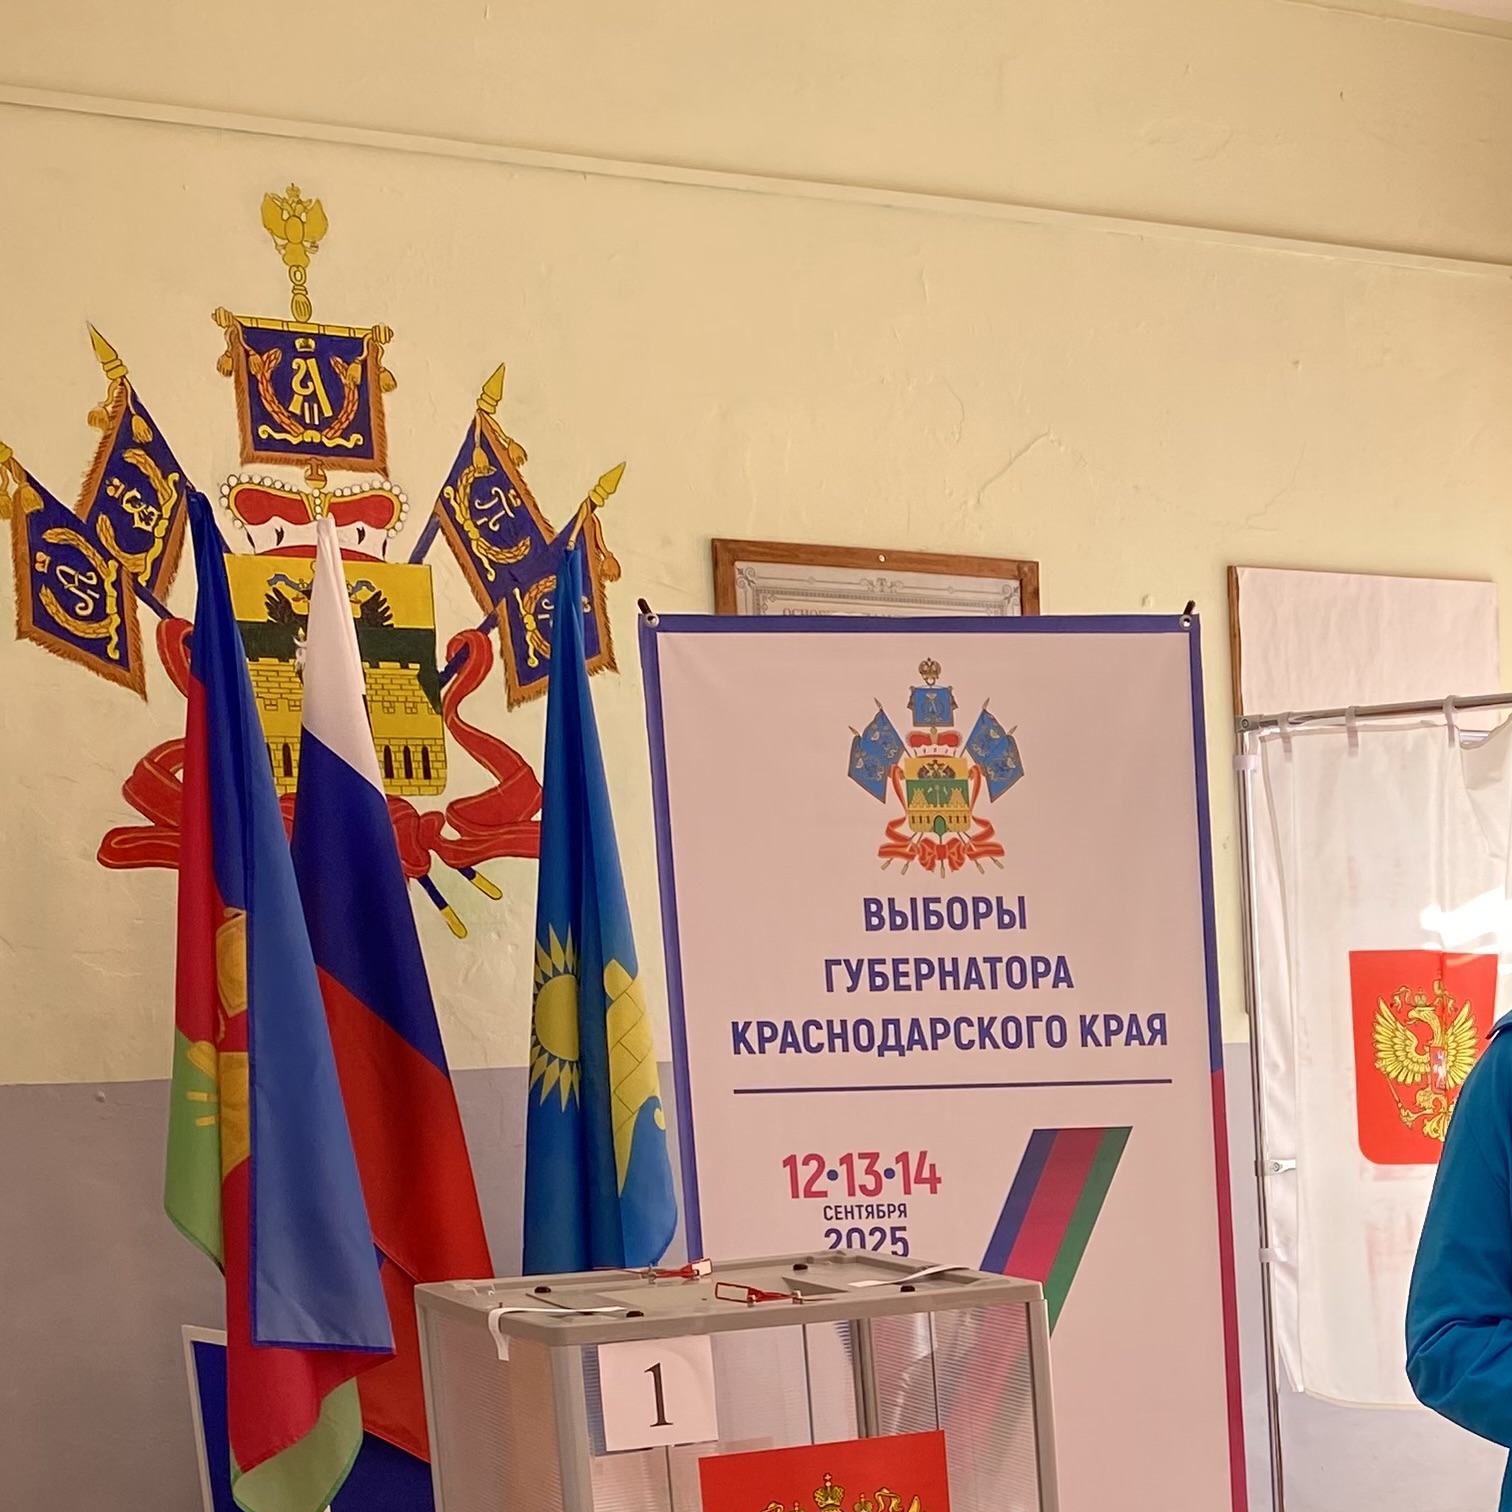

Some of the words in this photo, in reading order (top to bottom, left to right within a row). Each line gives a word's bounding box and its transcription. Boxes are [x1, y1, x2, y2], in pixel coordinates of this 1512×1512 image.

[863, 895, 1027, 932] ВЫБОРЫ
[824, 955, 1075, 993] ГУБЕРНАТОРА
[731, 1014, 1068, 1058] КРАСНОДАРСКОГО
[1080, 1012, 1168, 1048] КРАЯ
[823, 1202, 908, 1221] СЕНТЯБРЯ
[824, 1225, 910, 1258] 2025
[643, 1361, 674, 1428] 1
